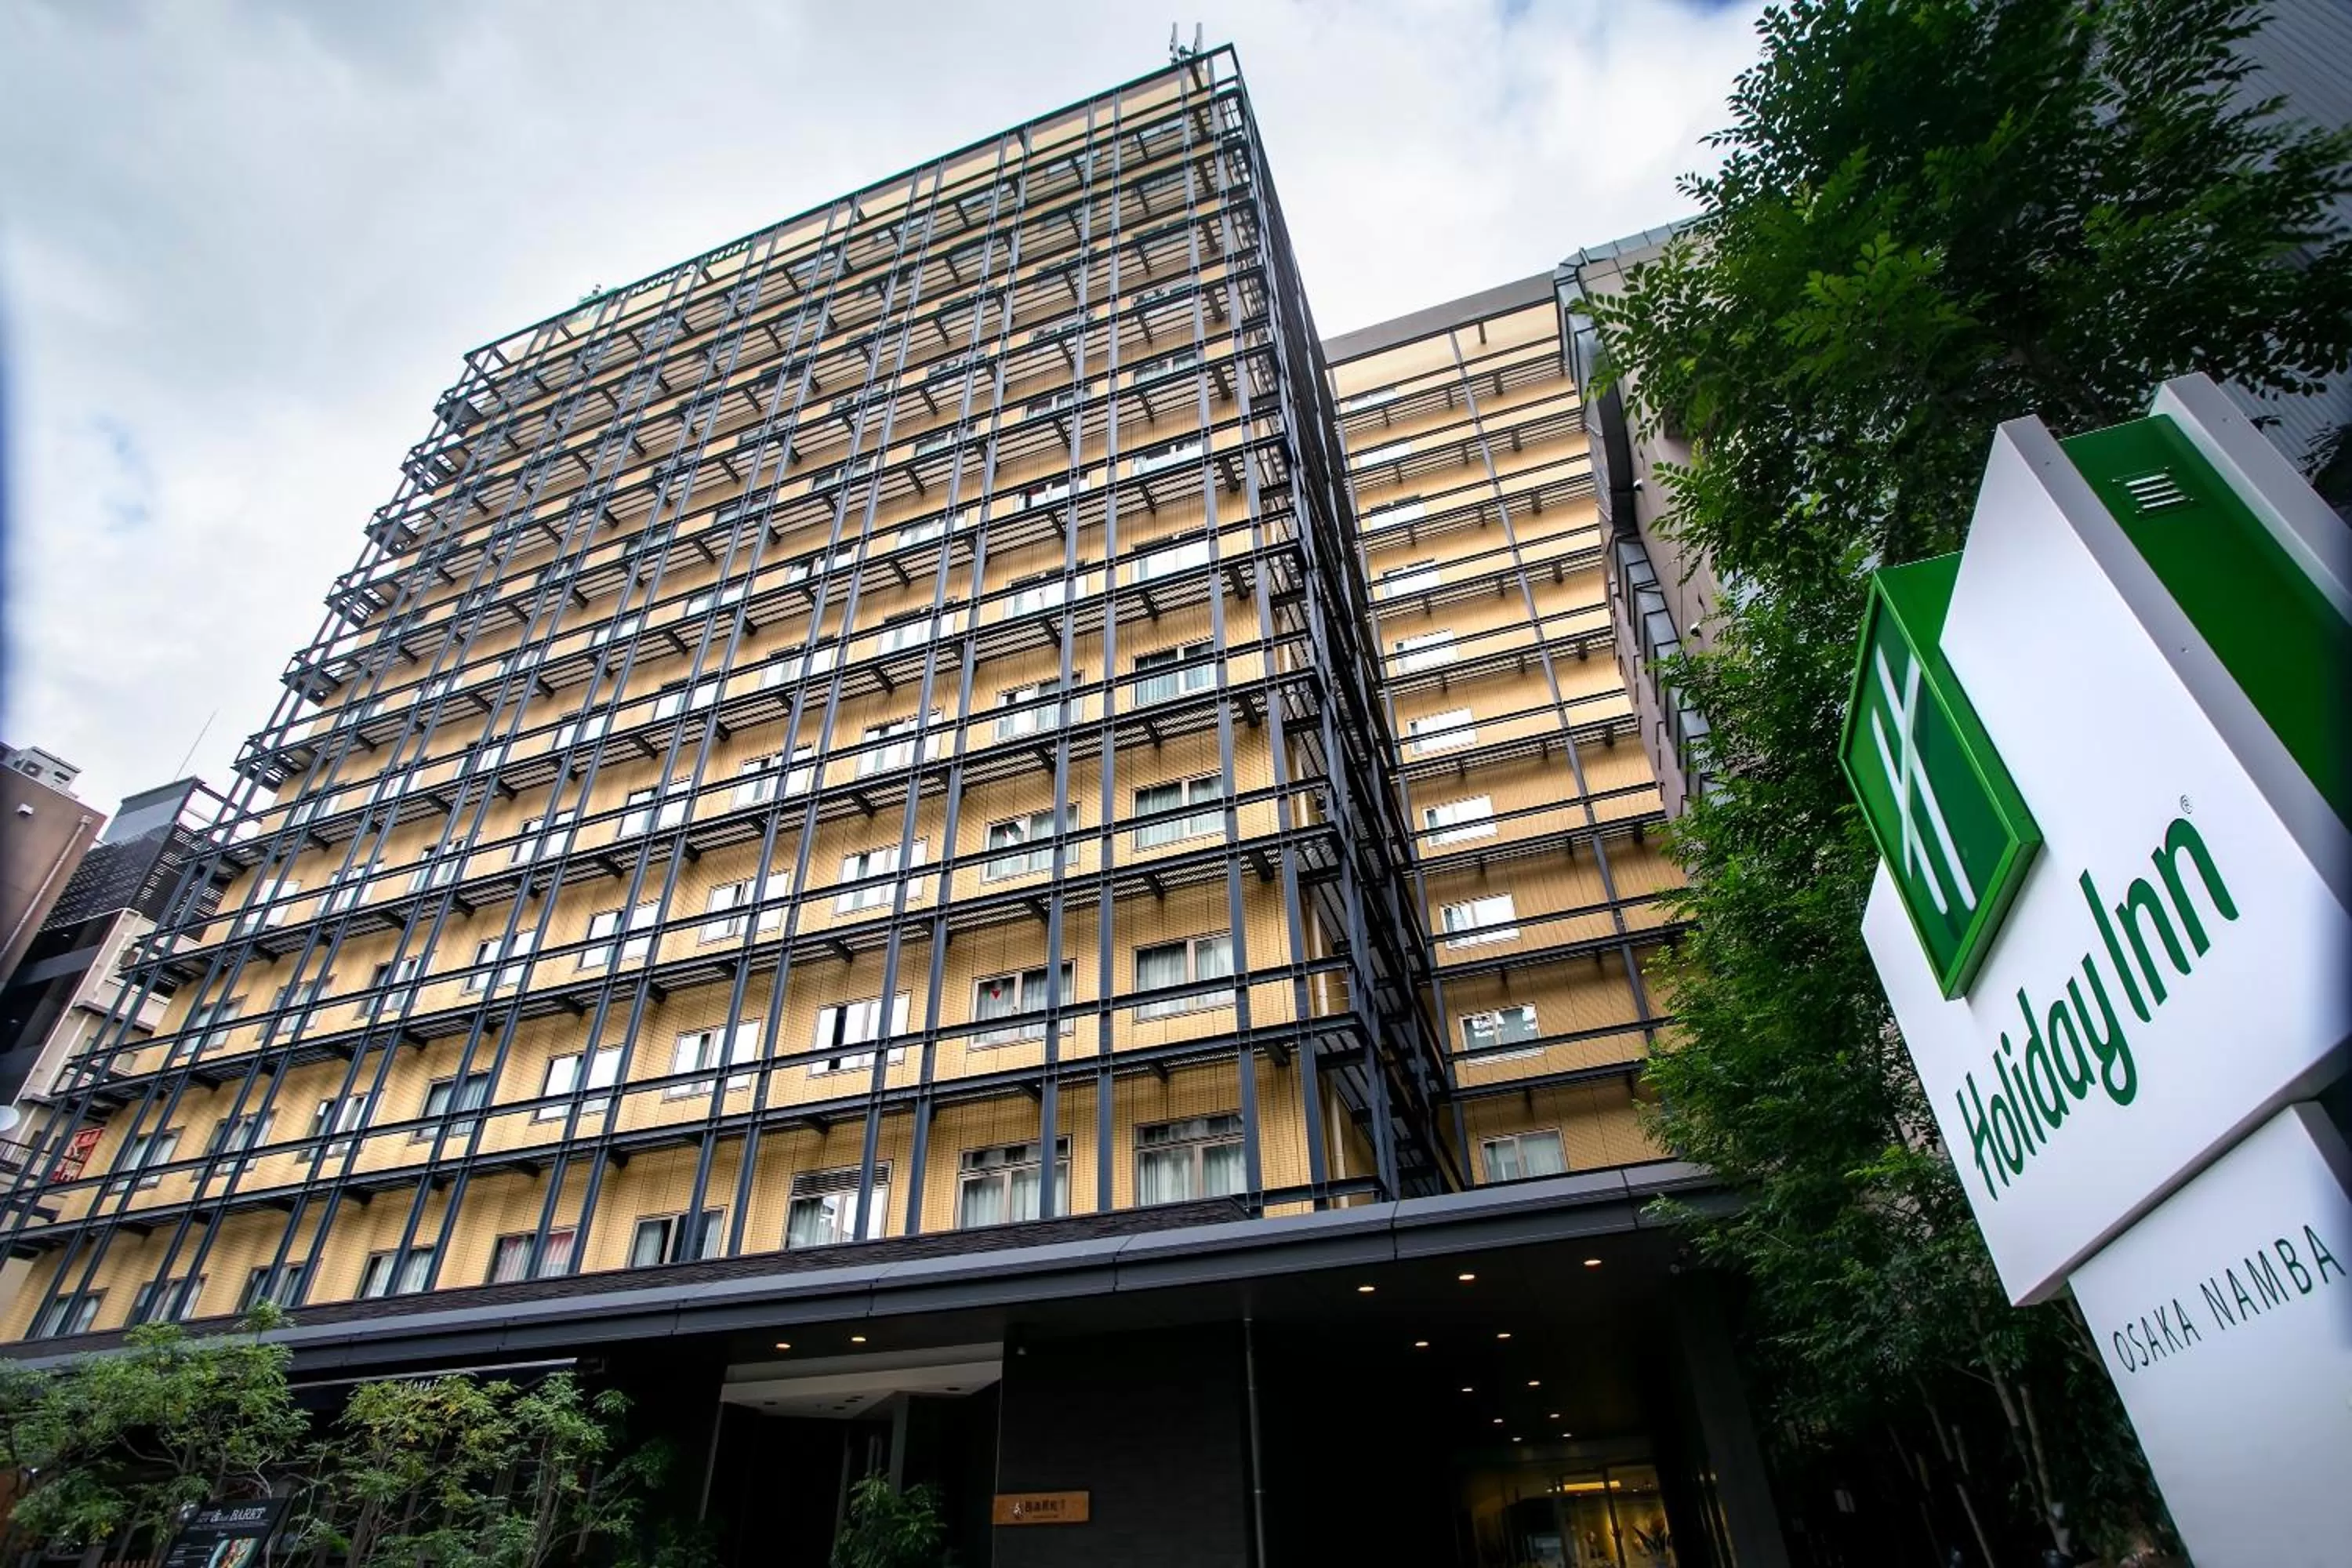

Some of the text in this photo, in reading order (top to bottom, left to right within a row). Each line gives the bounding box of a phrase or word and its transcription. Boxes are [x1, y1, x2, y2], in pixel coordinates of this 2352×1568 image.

[1955, 818, 2241, 1203] Holiday Inn
[2113, 1224, 2347, 1373] OSAKA NAMBA
